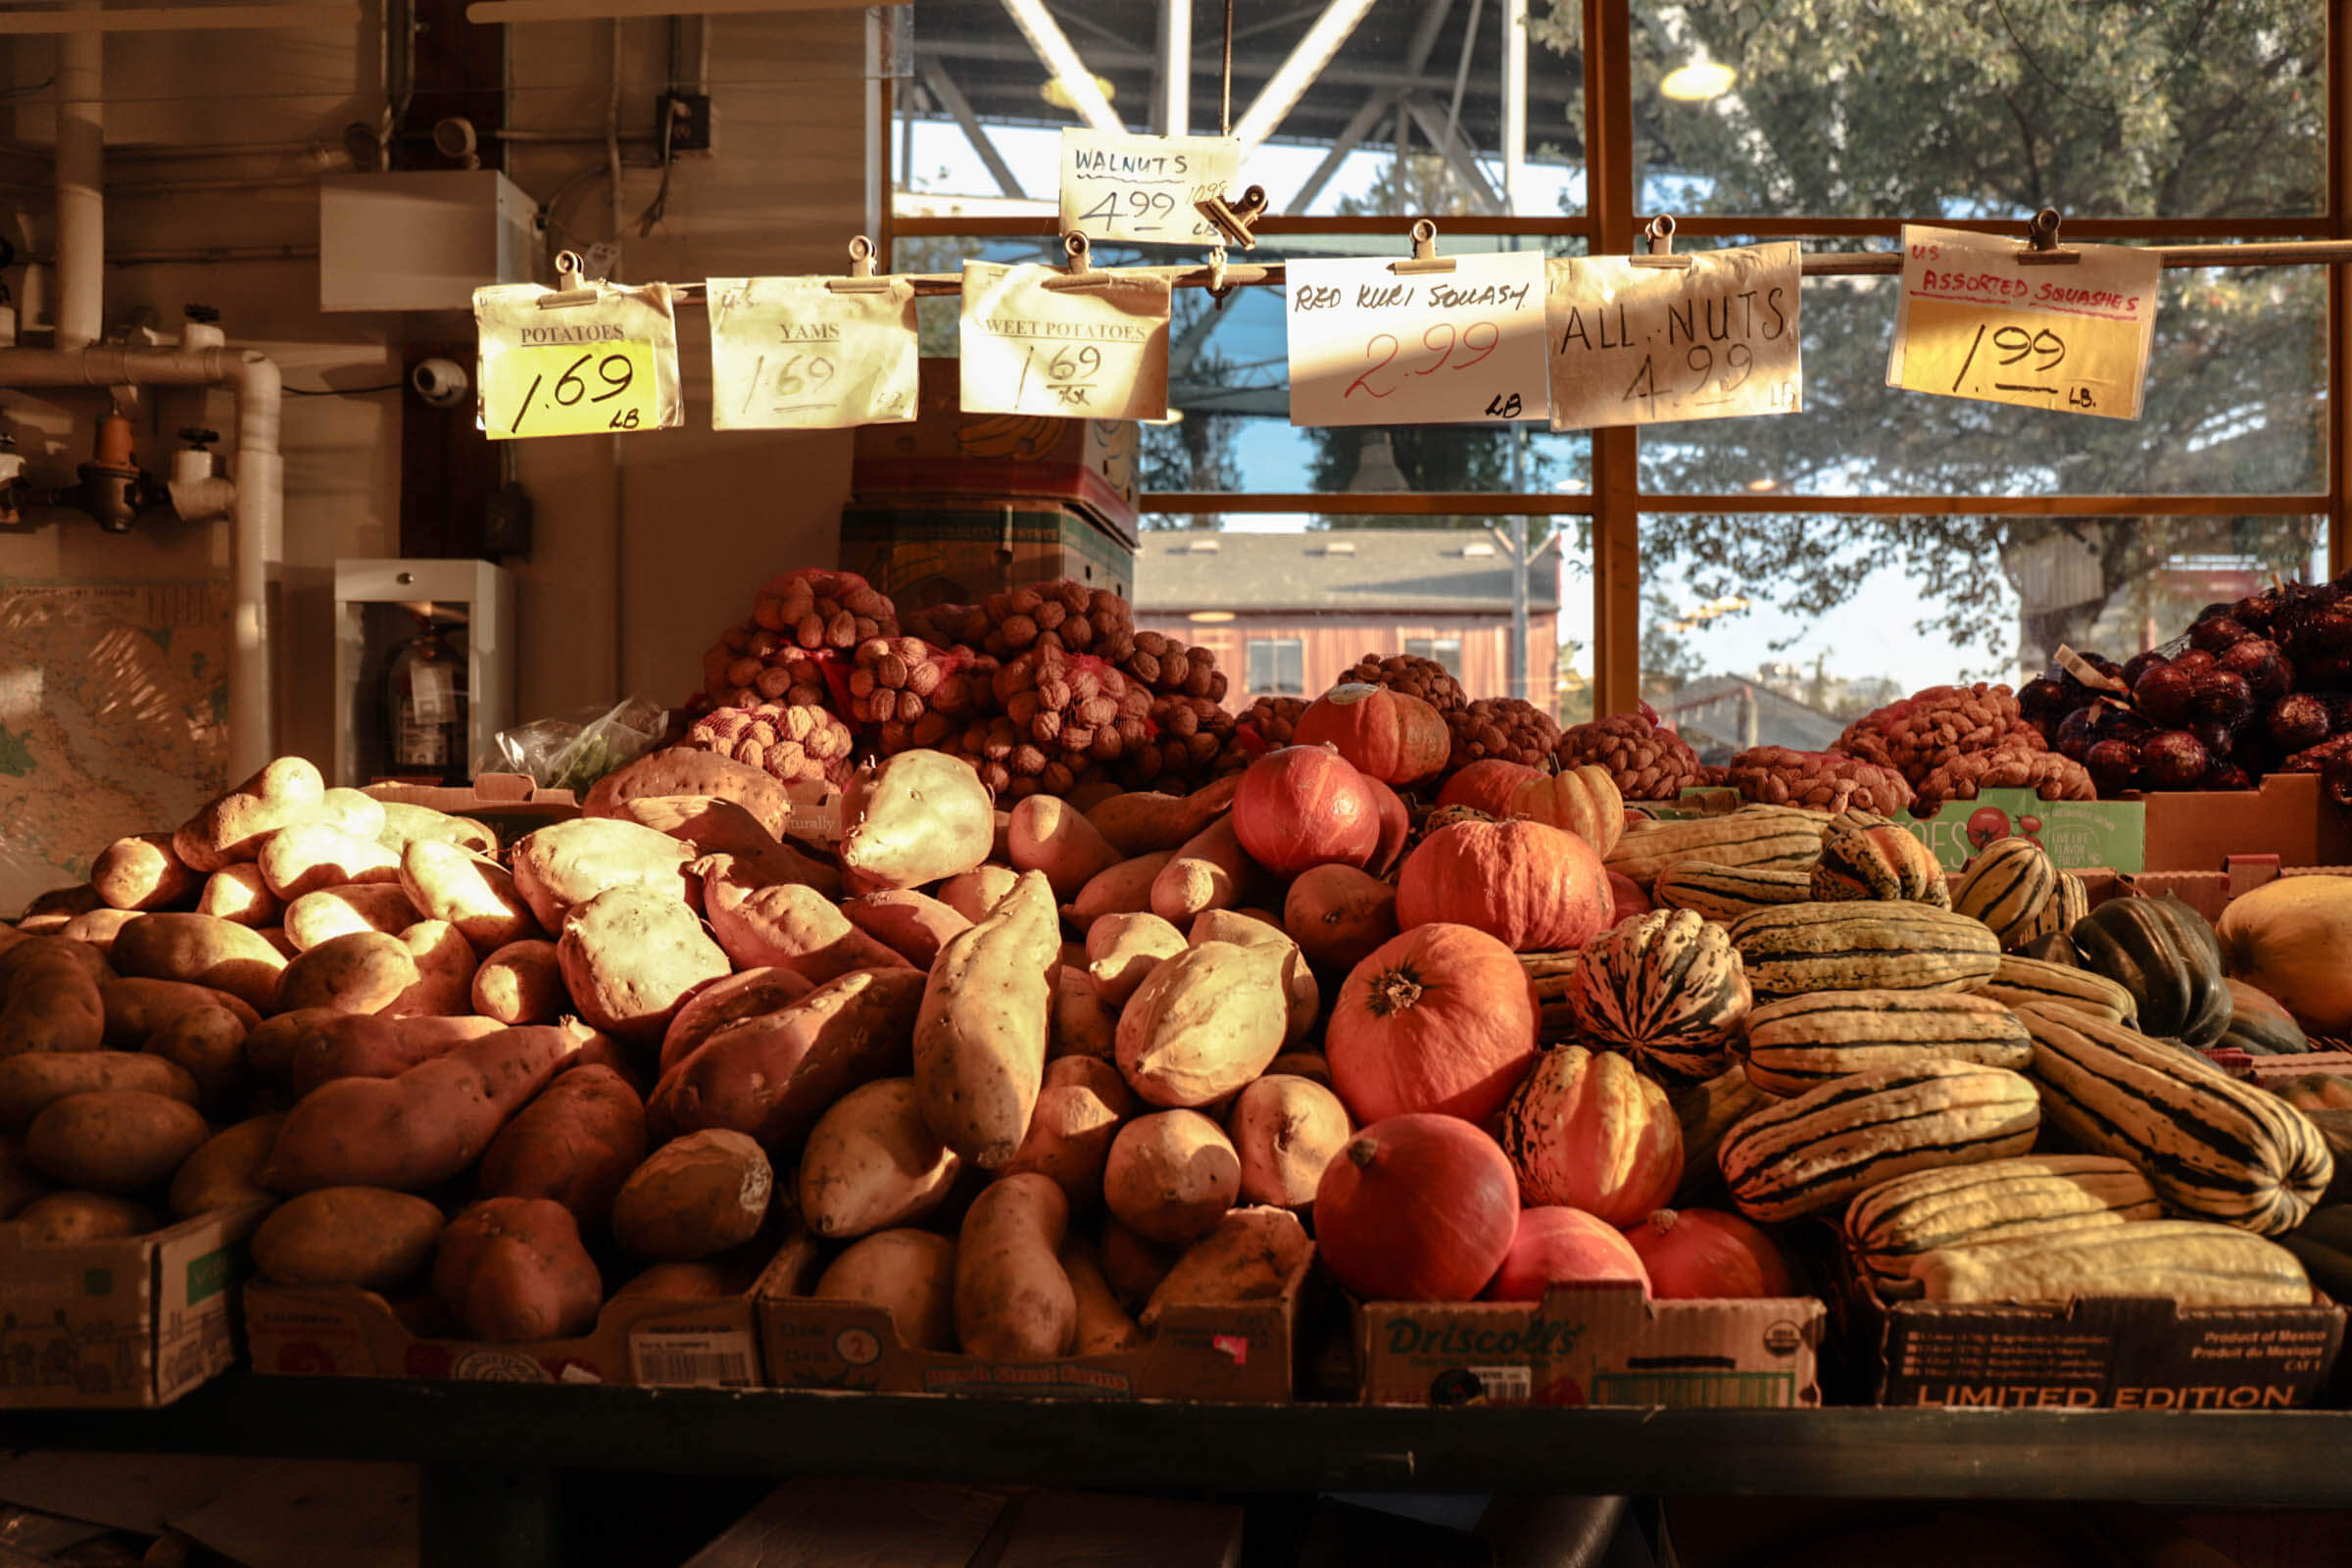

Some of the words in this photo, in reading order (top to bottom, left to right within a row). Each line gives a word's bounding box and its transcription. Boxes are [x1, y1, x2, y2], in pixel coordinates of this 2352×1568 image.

[1075, 148, 1188, 174] WALNUTS
[1295, 283, 1342, 313] RED
[1356, 283, 1415, 309] KURI
[1923, 270, 2029, 298] ASSORTED
[2034, 282, 2140, 312] SQUASHES
[520, 323, 625, 343] POTATOES
[780, 322, 840, 340] YAMS
[983, 318, 1042, 336] WEET
[1046, 321, 1146, 339] POTATOES
[1560, 303, 1636, 354] ALL
[1667, 287, 1785, 346] NUTS
[1344, 320, 1500, 399] 2.99
[1952, 323, 2067, 393] 1.99
[511, 353, 634, 434] 1.69
[1621, 343, 1754, 419] 4.99
[609, 407, 640, 429] LB
[1485, 393, 1522, 418] LB
[850, 1334, 865, 1358] 2
[1385, 1317, 1579, 1356] Driscoll's
[2203, 1330, 2260, 1345] Product
[2260, 1329, 2278, 1344] of
[2278, 1329, 2328, 1344] Mexico
[2190, 1345, 2243, 1359] Produit
[2244, 1346, 2265, 1358] du
[2265, 1345, 2325, 1359] Mexique
[2283, 1359, 2314, 1372] CAT
[1917, 1385, 2099, 1408] LIMITED
[2114, 1385, 2298, 1409] EDITION
